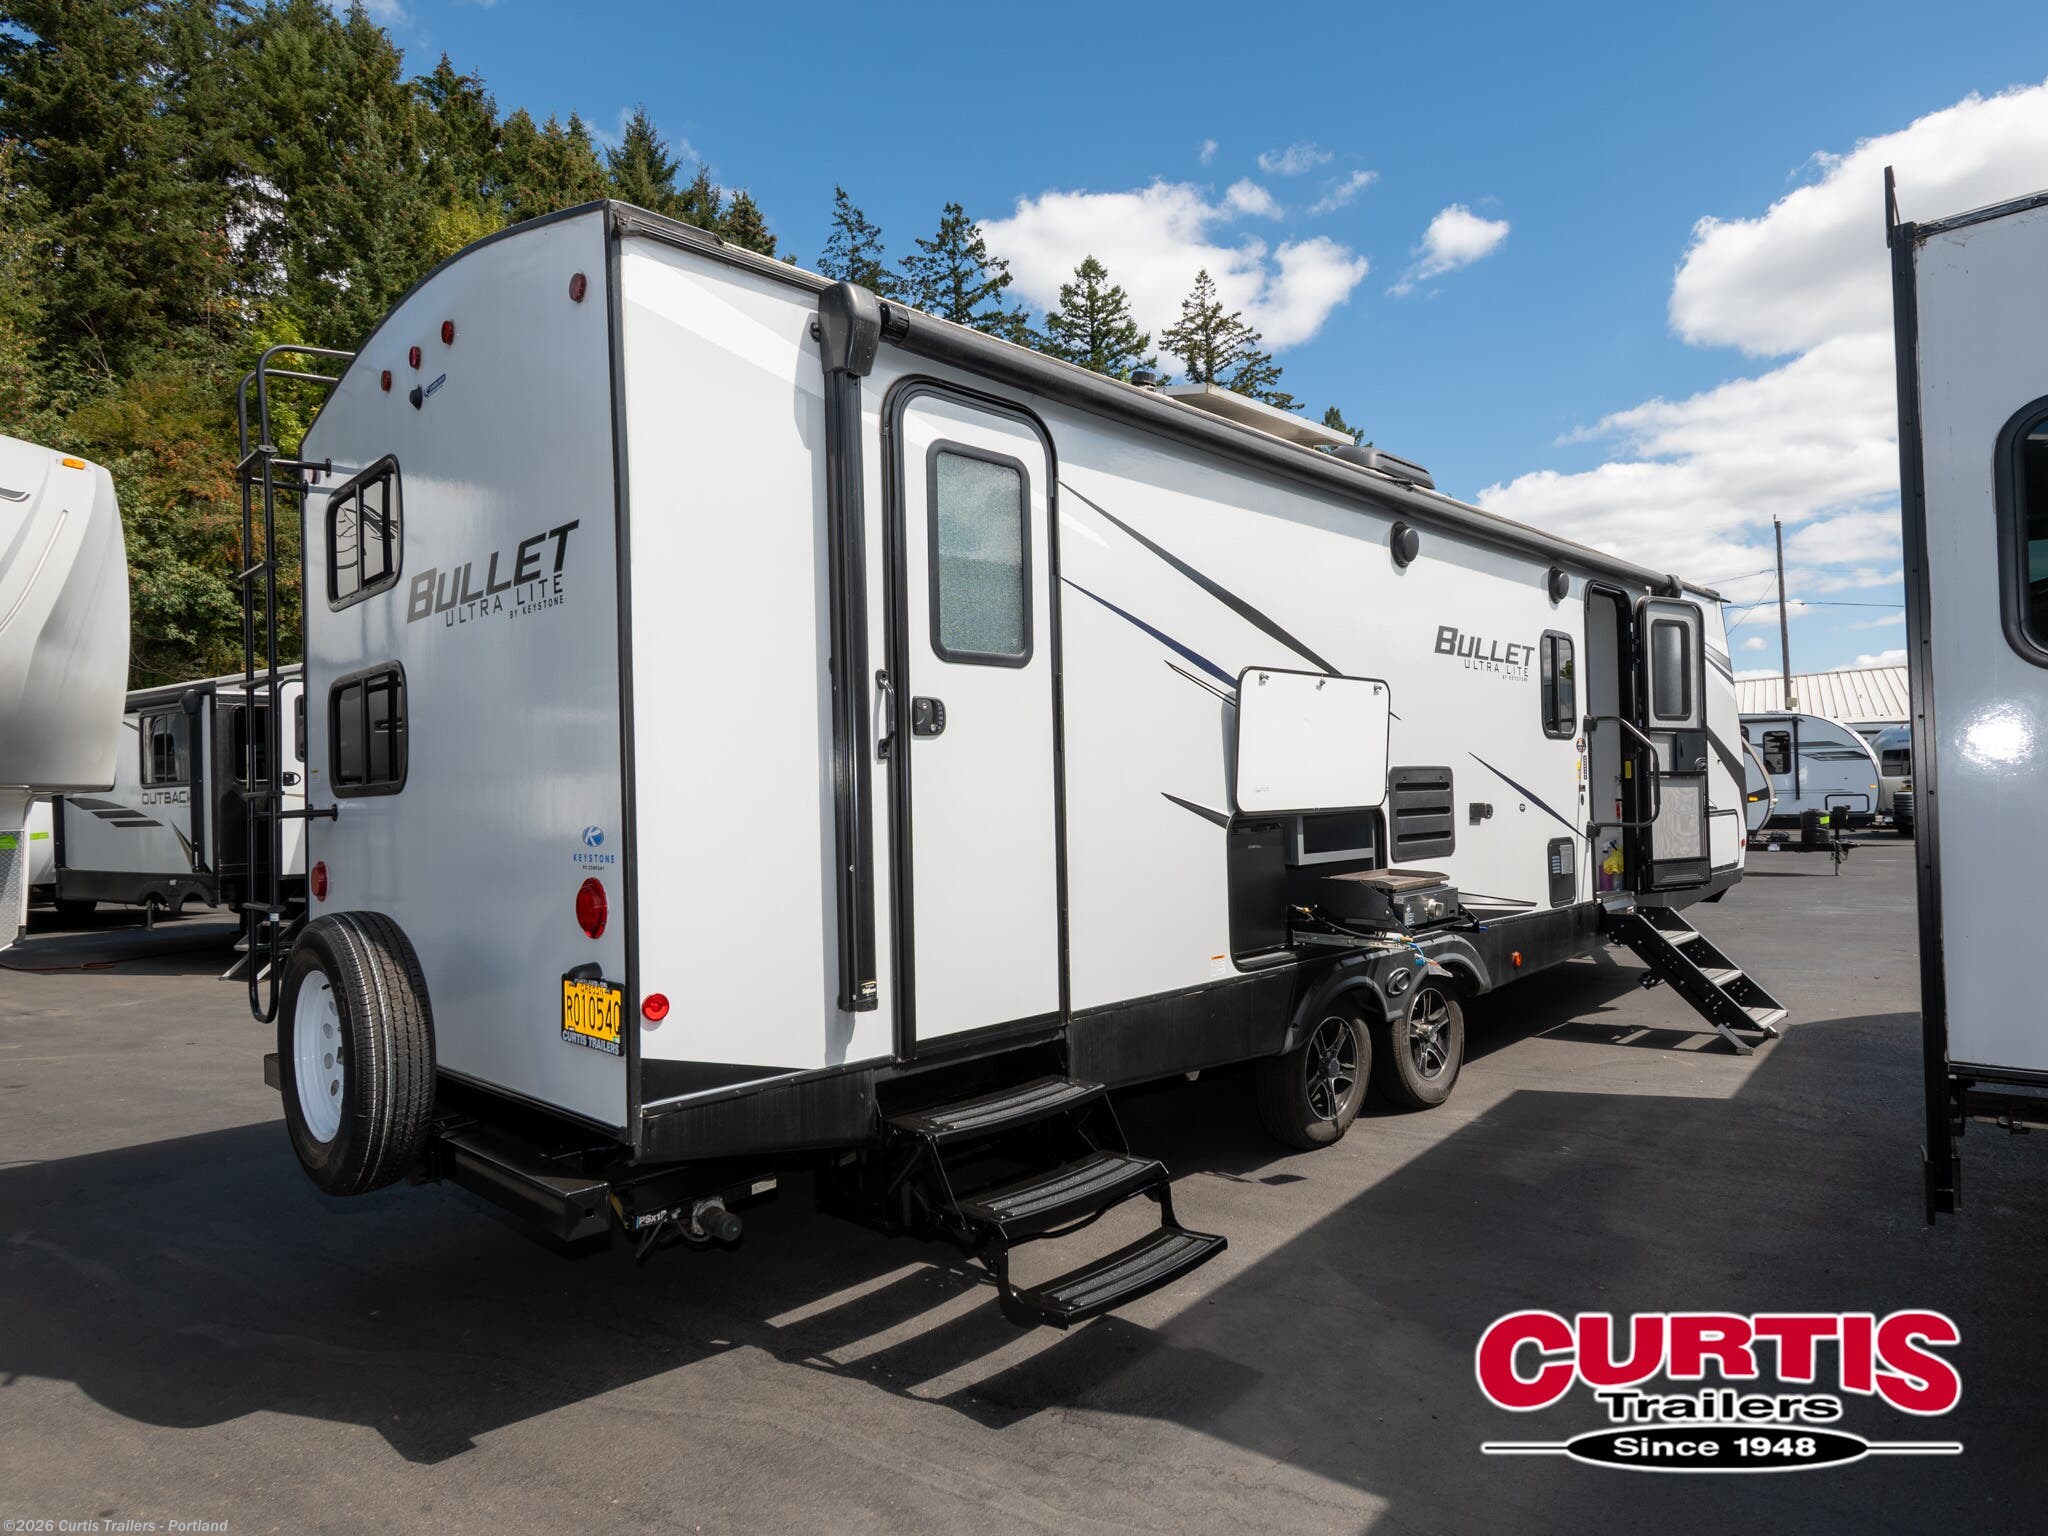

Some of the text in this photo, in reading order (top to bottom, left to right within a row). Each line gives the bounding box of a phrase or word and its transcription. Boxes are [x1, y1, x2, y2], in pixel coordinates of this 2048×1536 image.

[407, 518, 580, 625] BULLET
[445, 573, 563, 627] ULTRA LITE
[522, 594, 564, 616] KEYSTONE
[1434, 625, 1536, 667] BULLET
[1464, 659, 1529, 678] ULTRA LITE
[573, 853, 616, 864] KEYSTONE
[562, 1029, 620, 1057] CURTIS TRAILERS
